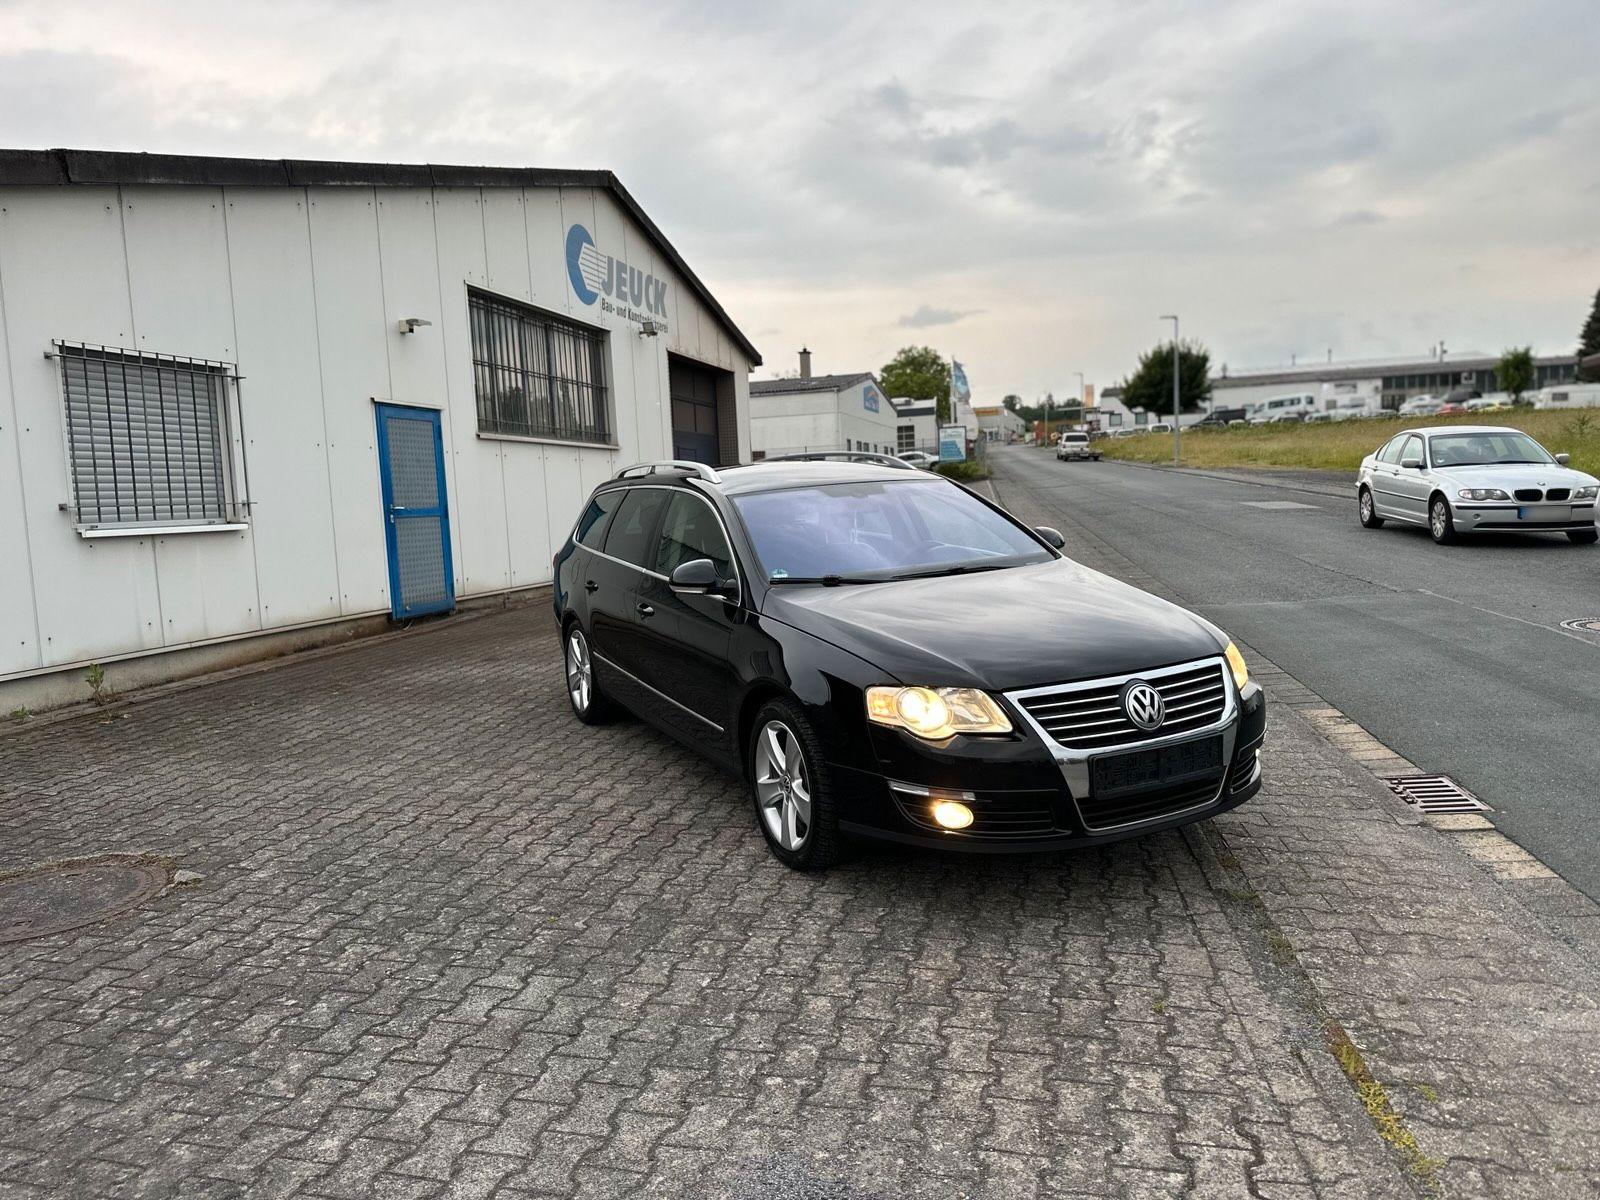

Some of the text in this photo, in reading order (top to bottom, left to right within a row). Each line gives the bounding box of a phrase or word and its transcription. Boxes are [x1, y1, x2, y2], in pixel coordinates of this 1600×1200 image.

[601, 255, 668, 319] JEUCK
[601, 297, 615, 313] Bau-
[1127, 686, 1164, 728] VW
